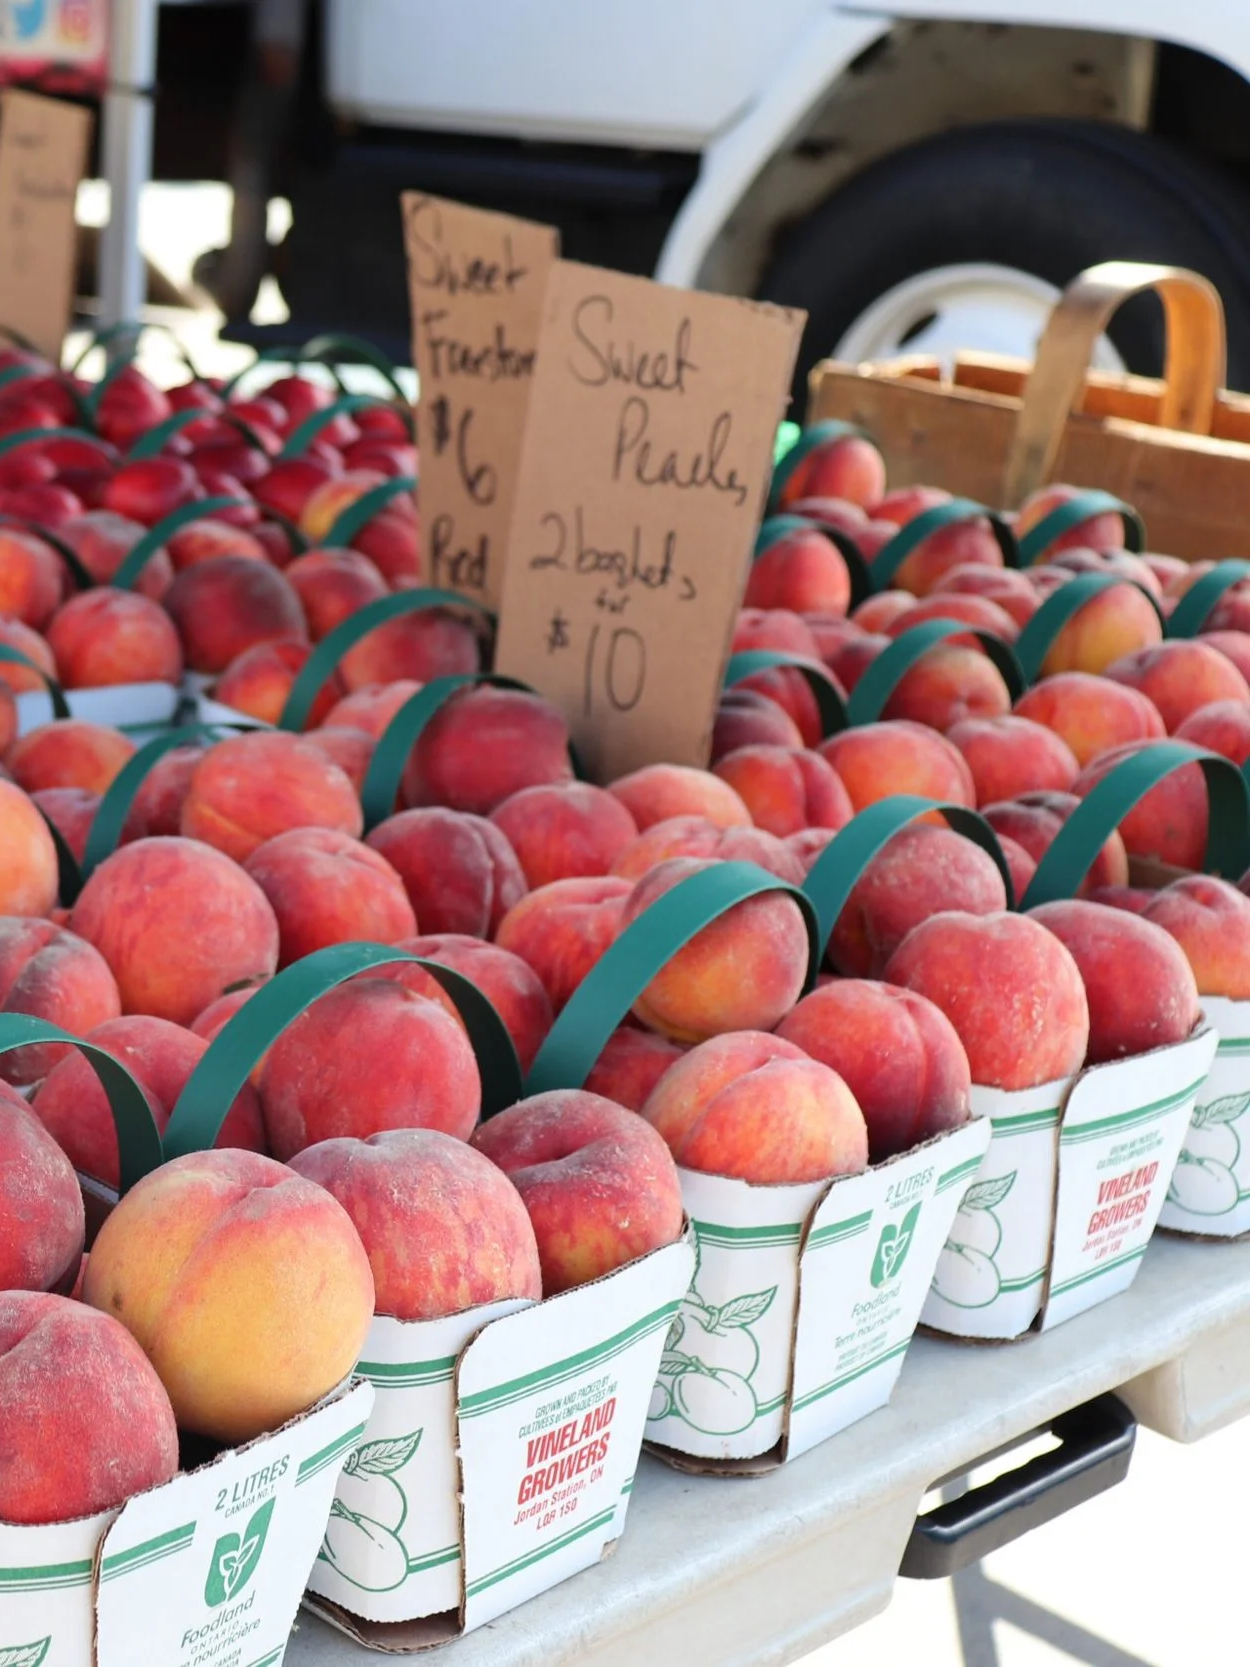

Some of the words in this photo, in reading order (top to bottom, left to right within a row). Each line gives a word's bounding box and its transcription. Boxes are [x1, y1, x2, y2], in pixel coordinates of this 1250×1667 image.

[409, 201, 529, 295] Sweet
[422, 307, 538, 384] Freeston
[567, 293, 700, 396] Sweet
[430, 512, 490, 591] Red
[544, 605, 648, 718] $10
[884, 1184, 895, 1205] 2
[894, 1165, 935, 1200] LITRES
[1086, 1189, 1152, 1237] GROWERS
[1096, 1160, 1160, 1206] VINELAND
[850, 1280, 902, 1320] Foodland
[534, 1397, 563, 1420] GROWN
[563, 1391, 578, 1408] AND
[577, 1379, 603, 1398] PACKED
[526, 1396, 618, 1469] VINELAND
[214, 1487, 229, 1513] 2
[231, 1453, 291, 1503] LITRES
[513, 1499, 549, 1526] Jordan
[550, 1479, 587, 1506] Station,
[589, 1464, 605, 1484] ON
[517, 1431, 611, 1506] GROWERS
[224, 1495, 256, 1519] CANADA
[180, 1589, 257, 1649] Foodland
[190, 1620, 240, 1656] ONTARIO
[193, 1618, 262, 1665] nourricière
